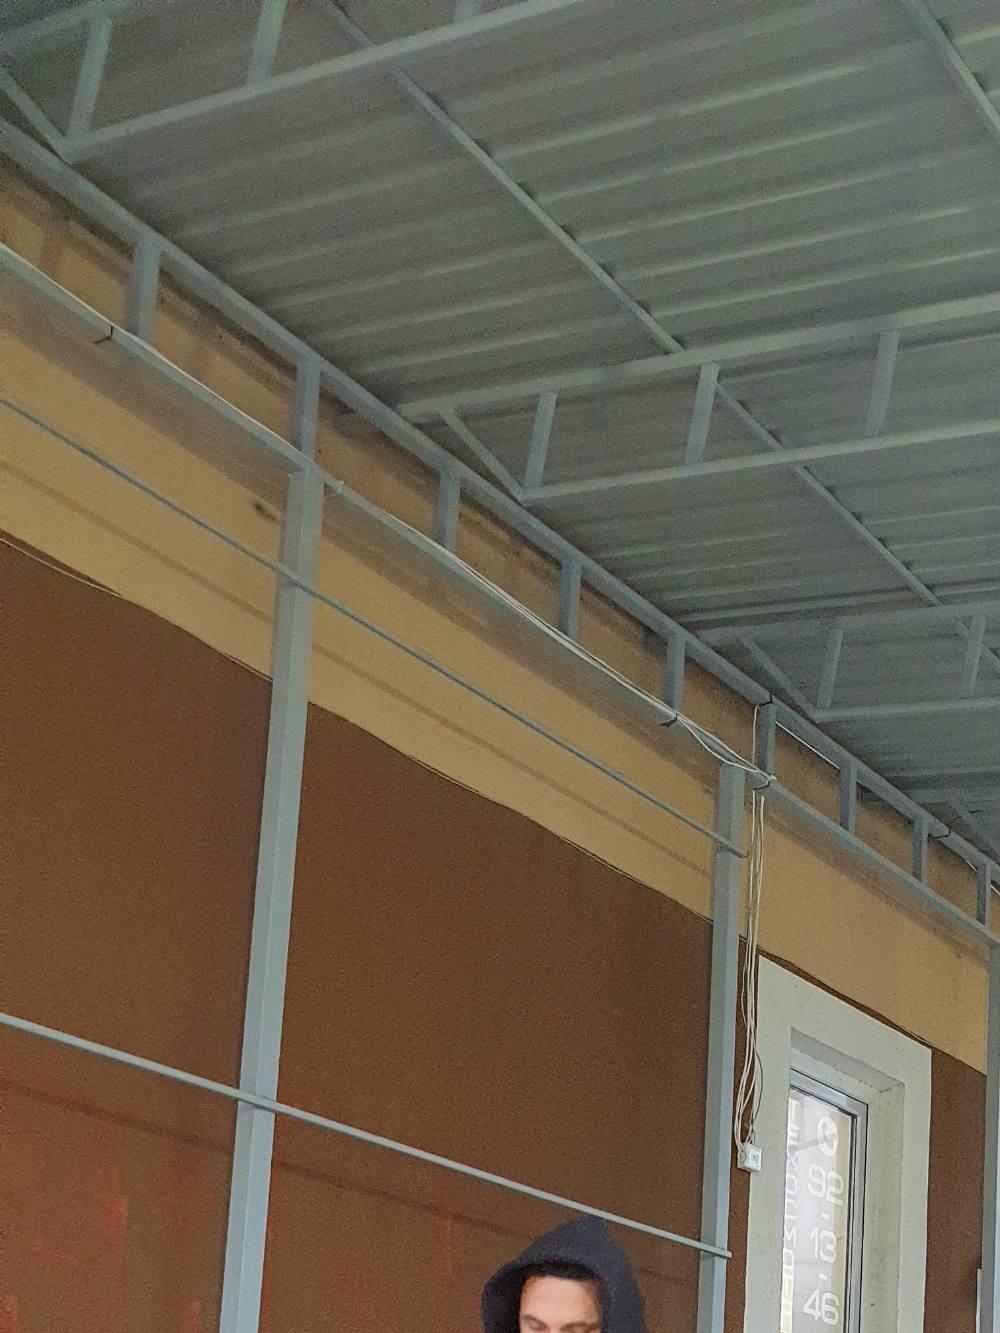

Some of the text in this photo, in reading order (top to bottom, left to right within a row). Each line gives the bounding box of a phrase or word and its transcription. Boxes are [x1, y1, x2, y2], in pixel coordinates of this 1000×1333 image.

[808, 1162, 844, 1206] 92
[809, 1226, 838, 1264] 13
[802, 1287, 840, 1327] 46
